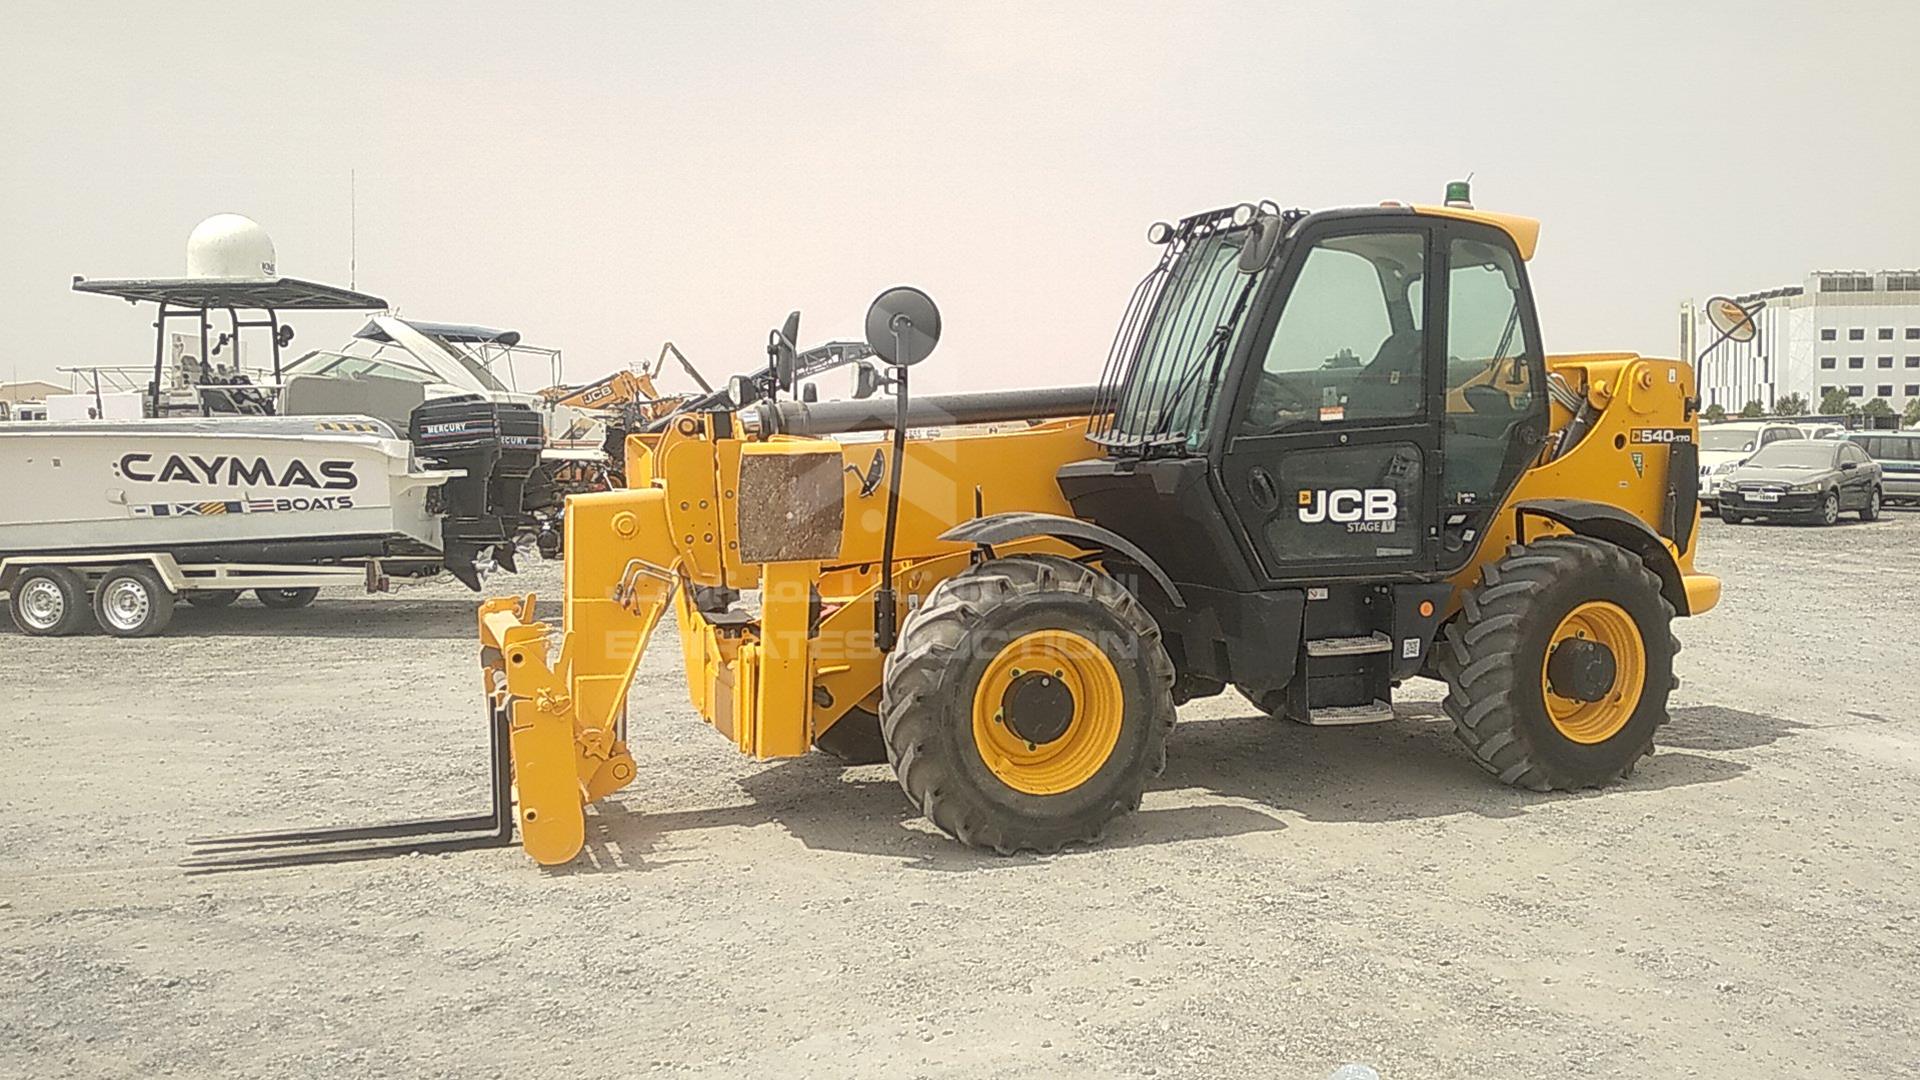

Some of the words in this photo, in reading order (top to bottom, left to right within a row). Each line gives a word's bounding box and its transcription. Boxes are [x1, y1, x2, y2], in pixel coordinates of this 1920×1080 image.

[584, 386, 612, 403] JCB
[427, 422, 466, 434] MERCURY
[120, 453, 358, 489] CAYMAS
[276, 496, 354, 511] BOATS
[1299, 489, 1397, 523] JCB
[1347, 521, 1380, 533] STAGE
